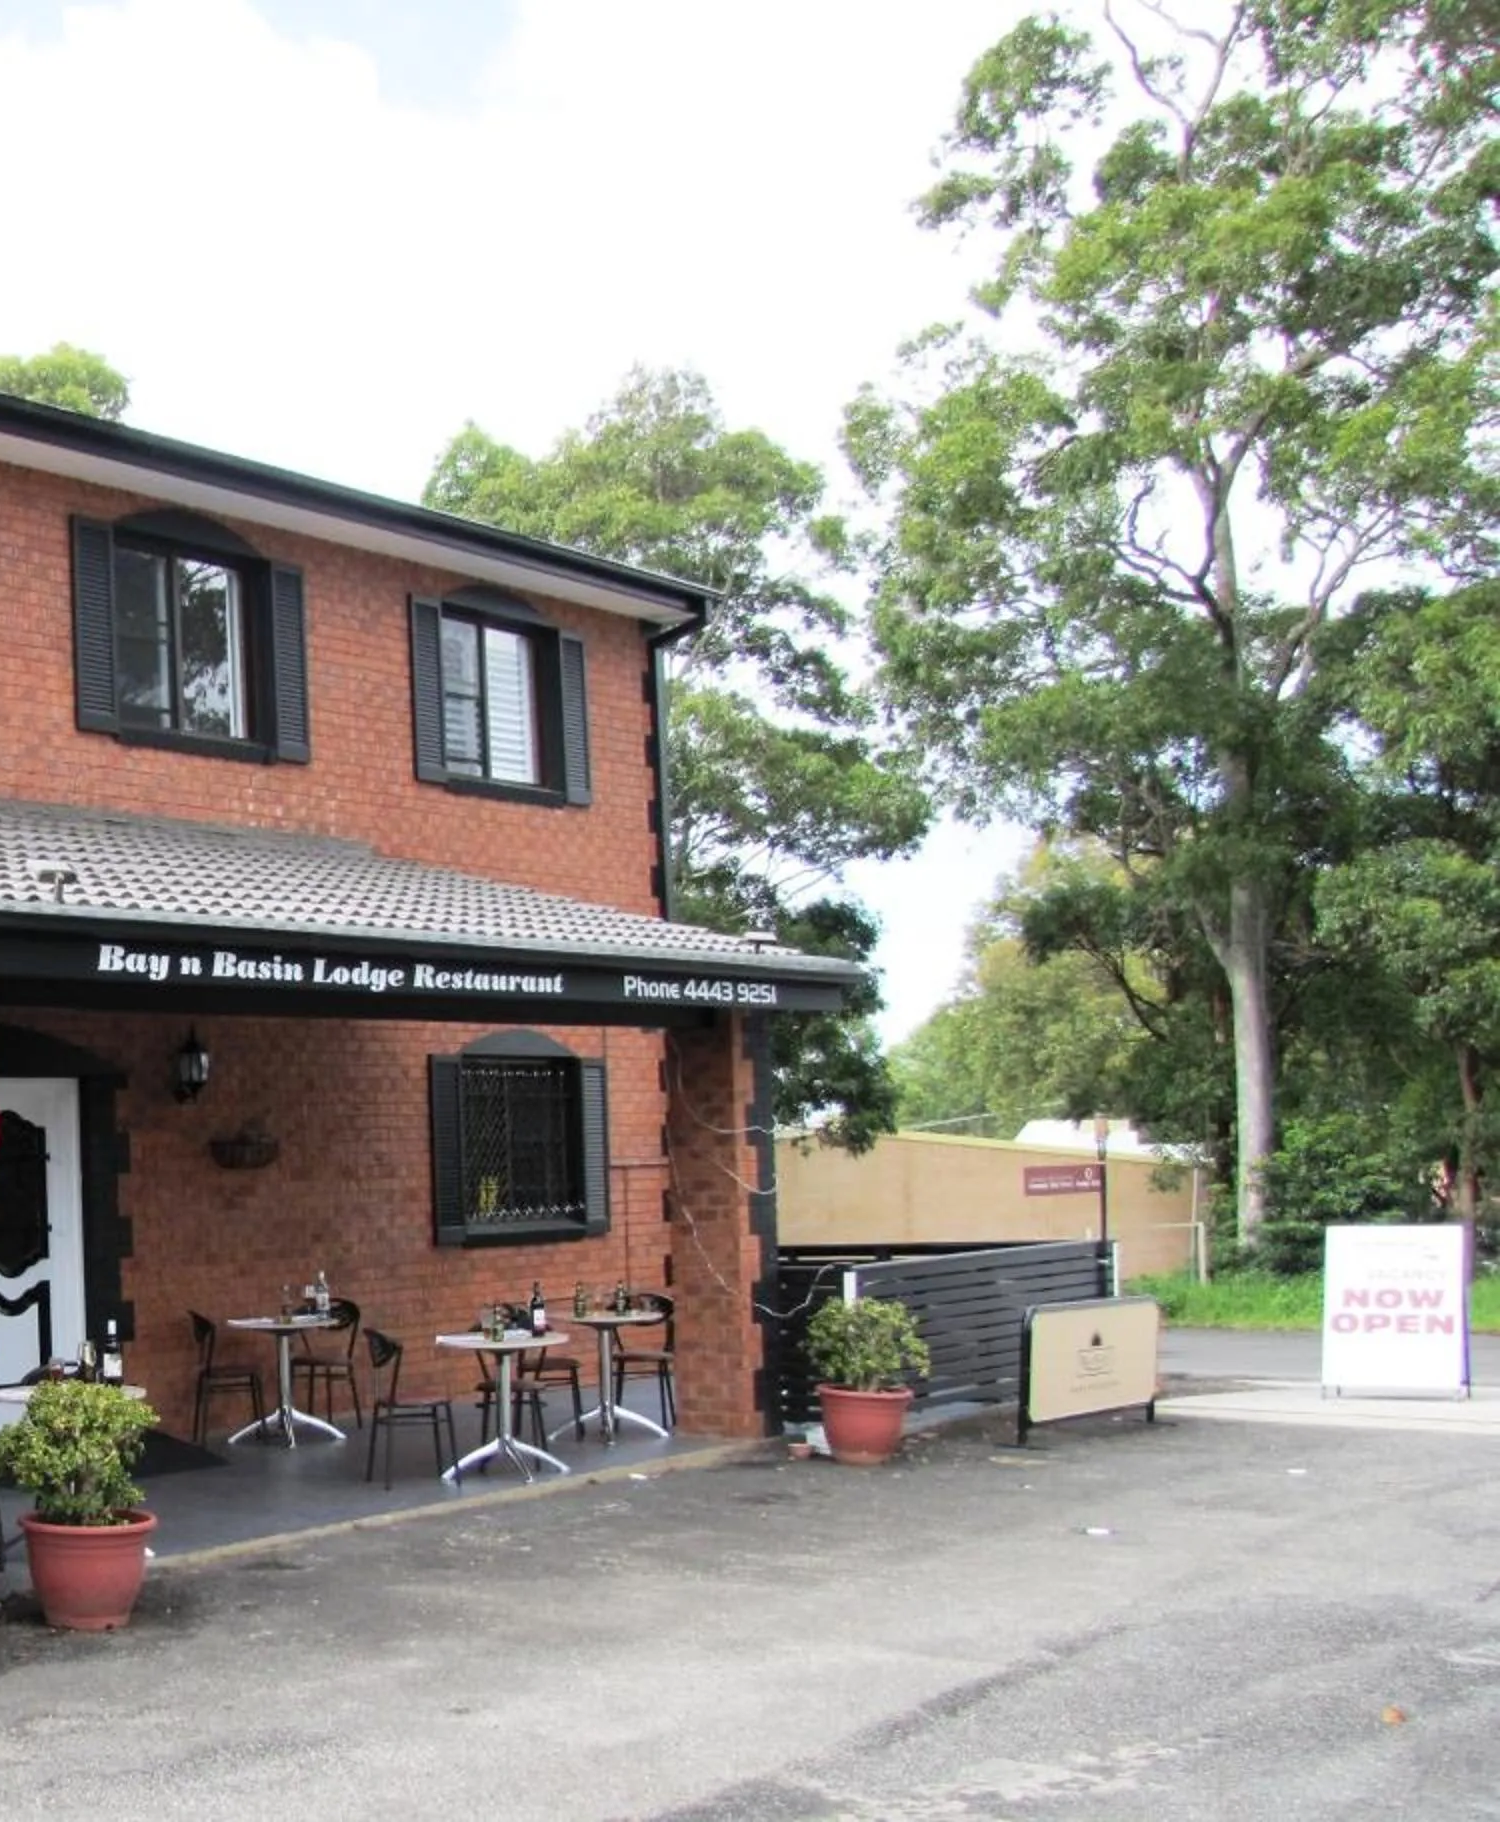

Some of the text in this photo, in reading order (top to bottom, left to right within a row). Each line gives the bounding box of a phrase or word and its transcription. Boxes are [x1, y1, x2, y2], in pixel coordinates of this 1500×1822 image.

[97, 943, 565, 994] Bay n Basin Lodge Restaurant
[623, 975, 777, 1004] Phone 4443 9251
[1342, 1289, 1445, 1309] NOW
[1331, 1313, 1455, 1335] OPEN
